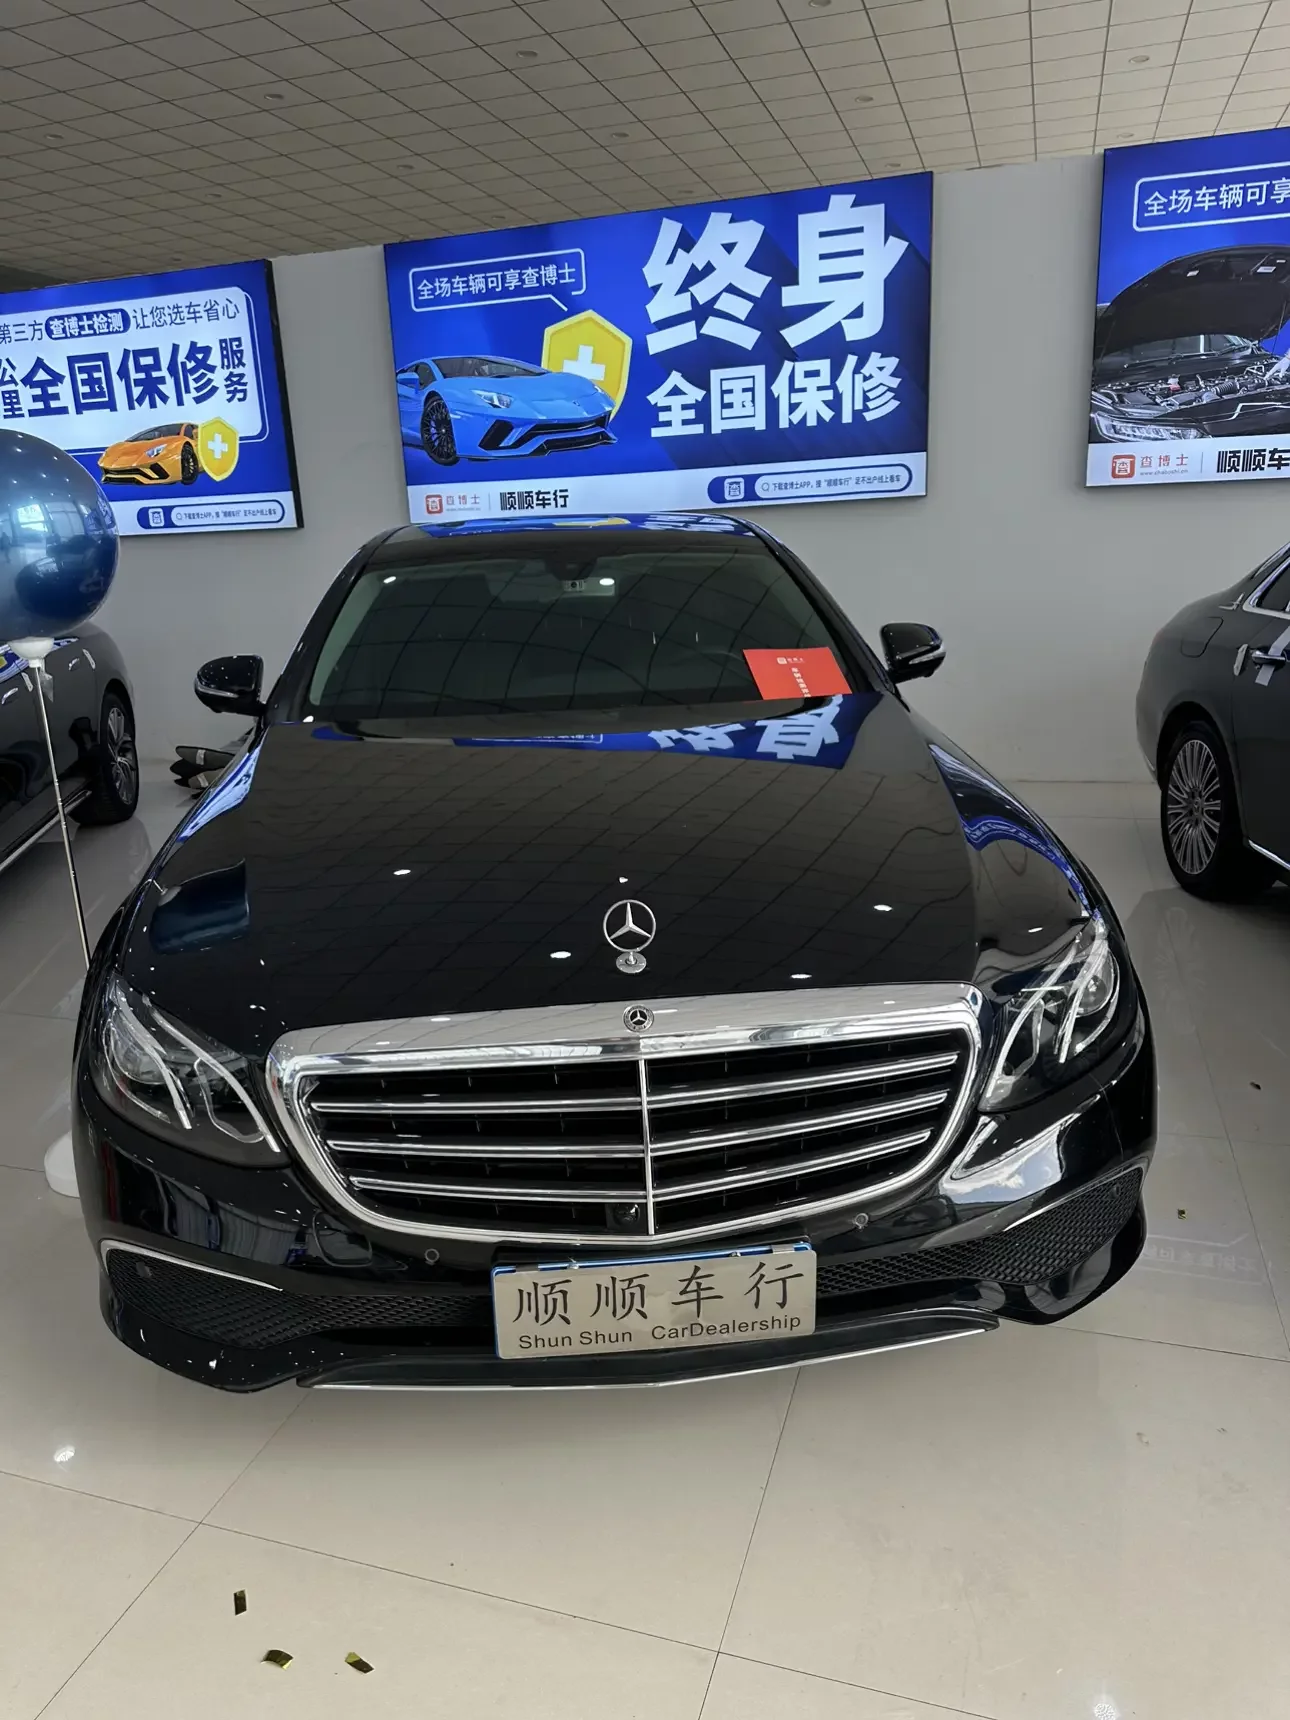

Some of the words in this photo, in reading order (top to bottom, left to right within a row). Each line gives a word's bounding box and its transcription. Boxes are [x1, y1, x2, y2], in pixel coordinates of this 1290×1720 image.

[1143, 177, 1290, 217] 全场车辆可享
[416, 262, 576, 301] 全场车辆可享查博士
[642, 193, 909, 356] 终身
[0, 320, 43, 345] 第三方
[50, 311, 124, 339] 查博士检测
[132, 297, 240, 330] 让您选车省心
[20, 340, 219, 419] 全国保修
[646, 352, 902, 439] 全国保修
[1140, 453, 1189, 468] 查博士
[499, 488, 569, 511] 顺顺车行
[512, 1261, 805, 1327] 顺顺车行
[519, 1334, 573, 1349] Shun
[579, 1329, 632, 1345] Shun
[651, 1315, 801, 1341] CarDealership
